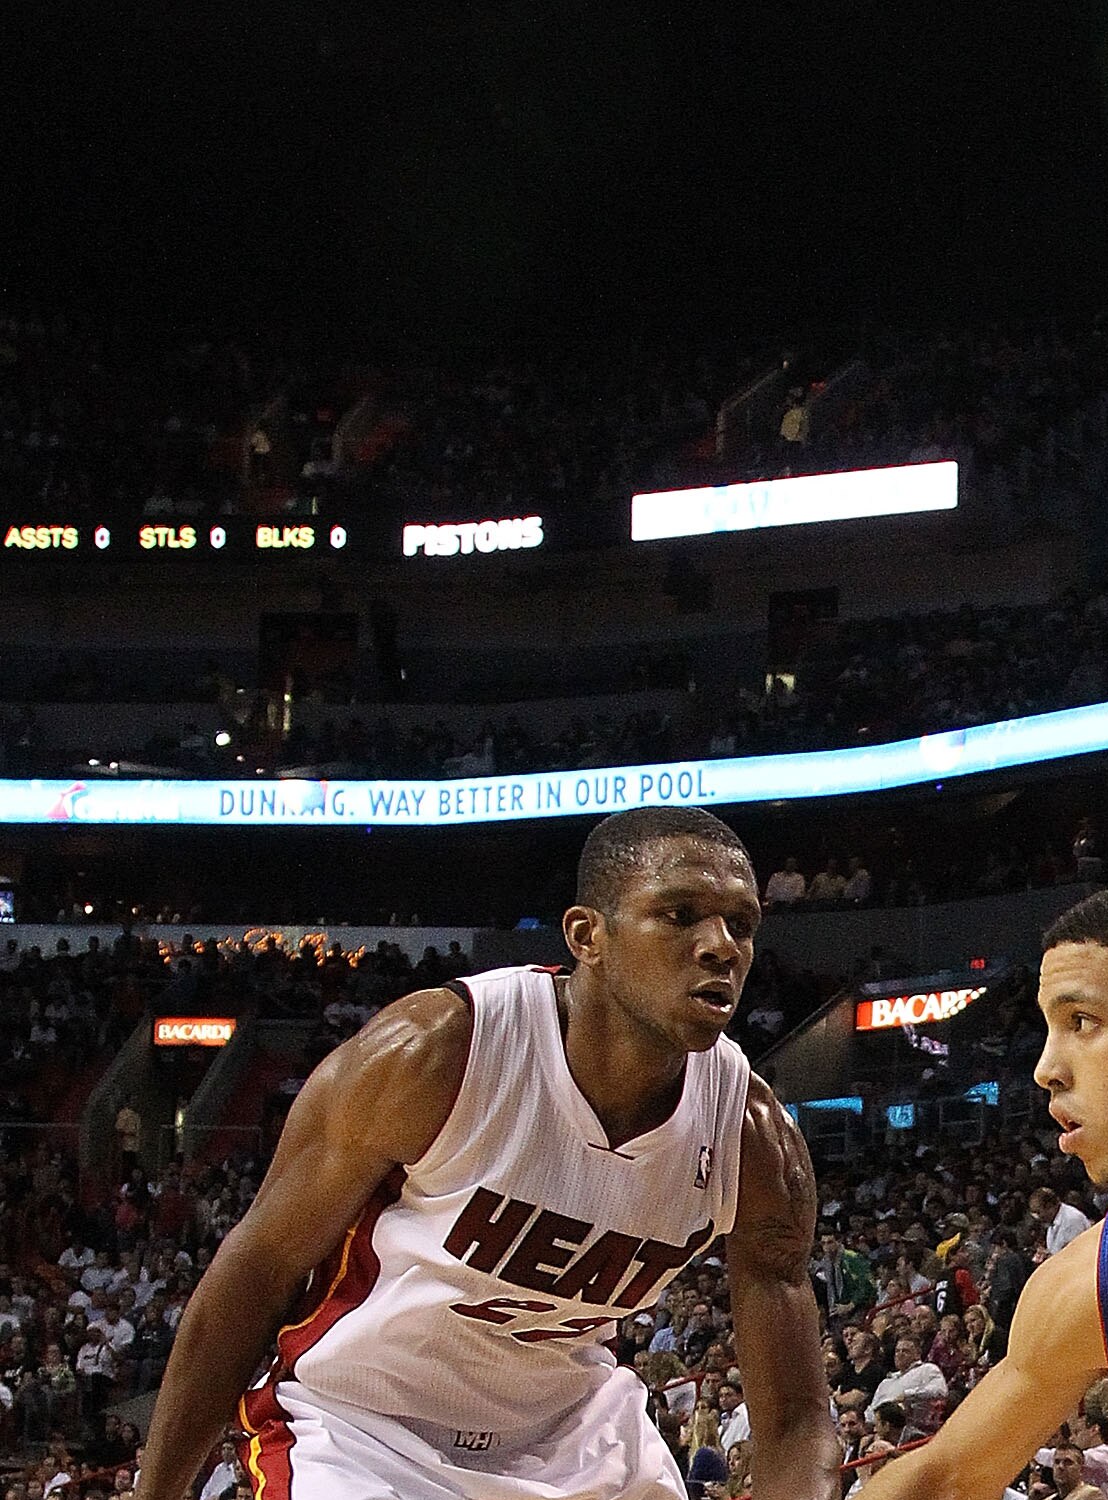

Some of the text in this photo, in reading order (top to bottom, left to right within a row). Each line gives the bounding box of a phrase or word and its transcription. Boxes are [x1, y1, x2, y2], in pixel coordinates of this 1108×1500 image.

[4, 526, 346, 549] ASSTS 0 STLS 0 BLKS 0
[402, 516, 543, 556] PISTONS
[369, 789, 425, 816] WAY
[438, 784, 524, 816] BETTER
[536, 780, 562, 809] IN
[575, 775, 627, 806] OUR
[640, 769, 716, 800] POOL.
[158, 1024, 232, 1040] BACARDI
[443, 1186, 714, 1309] HEAT
